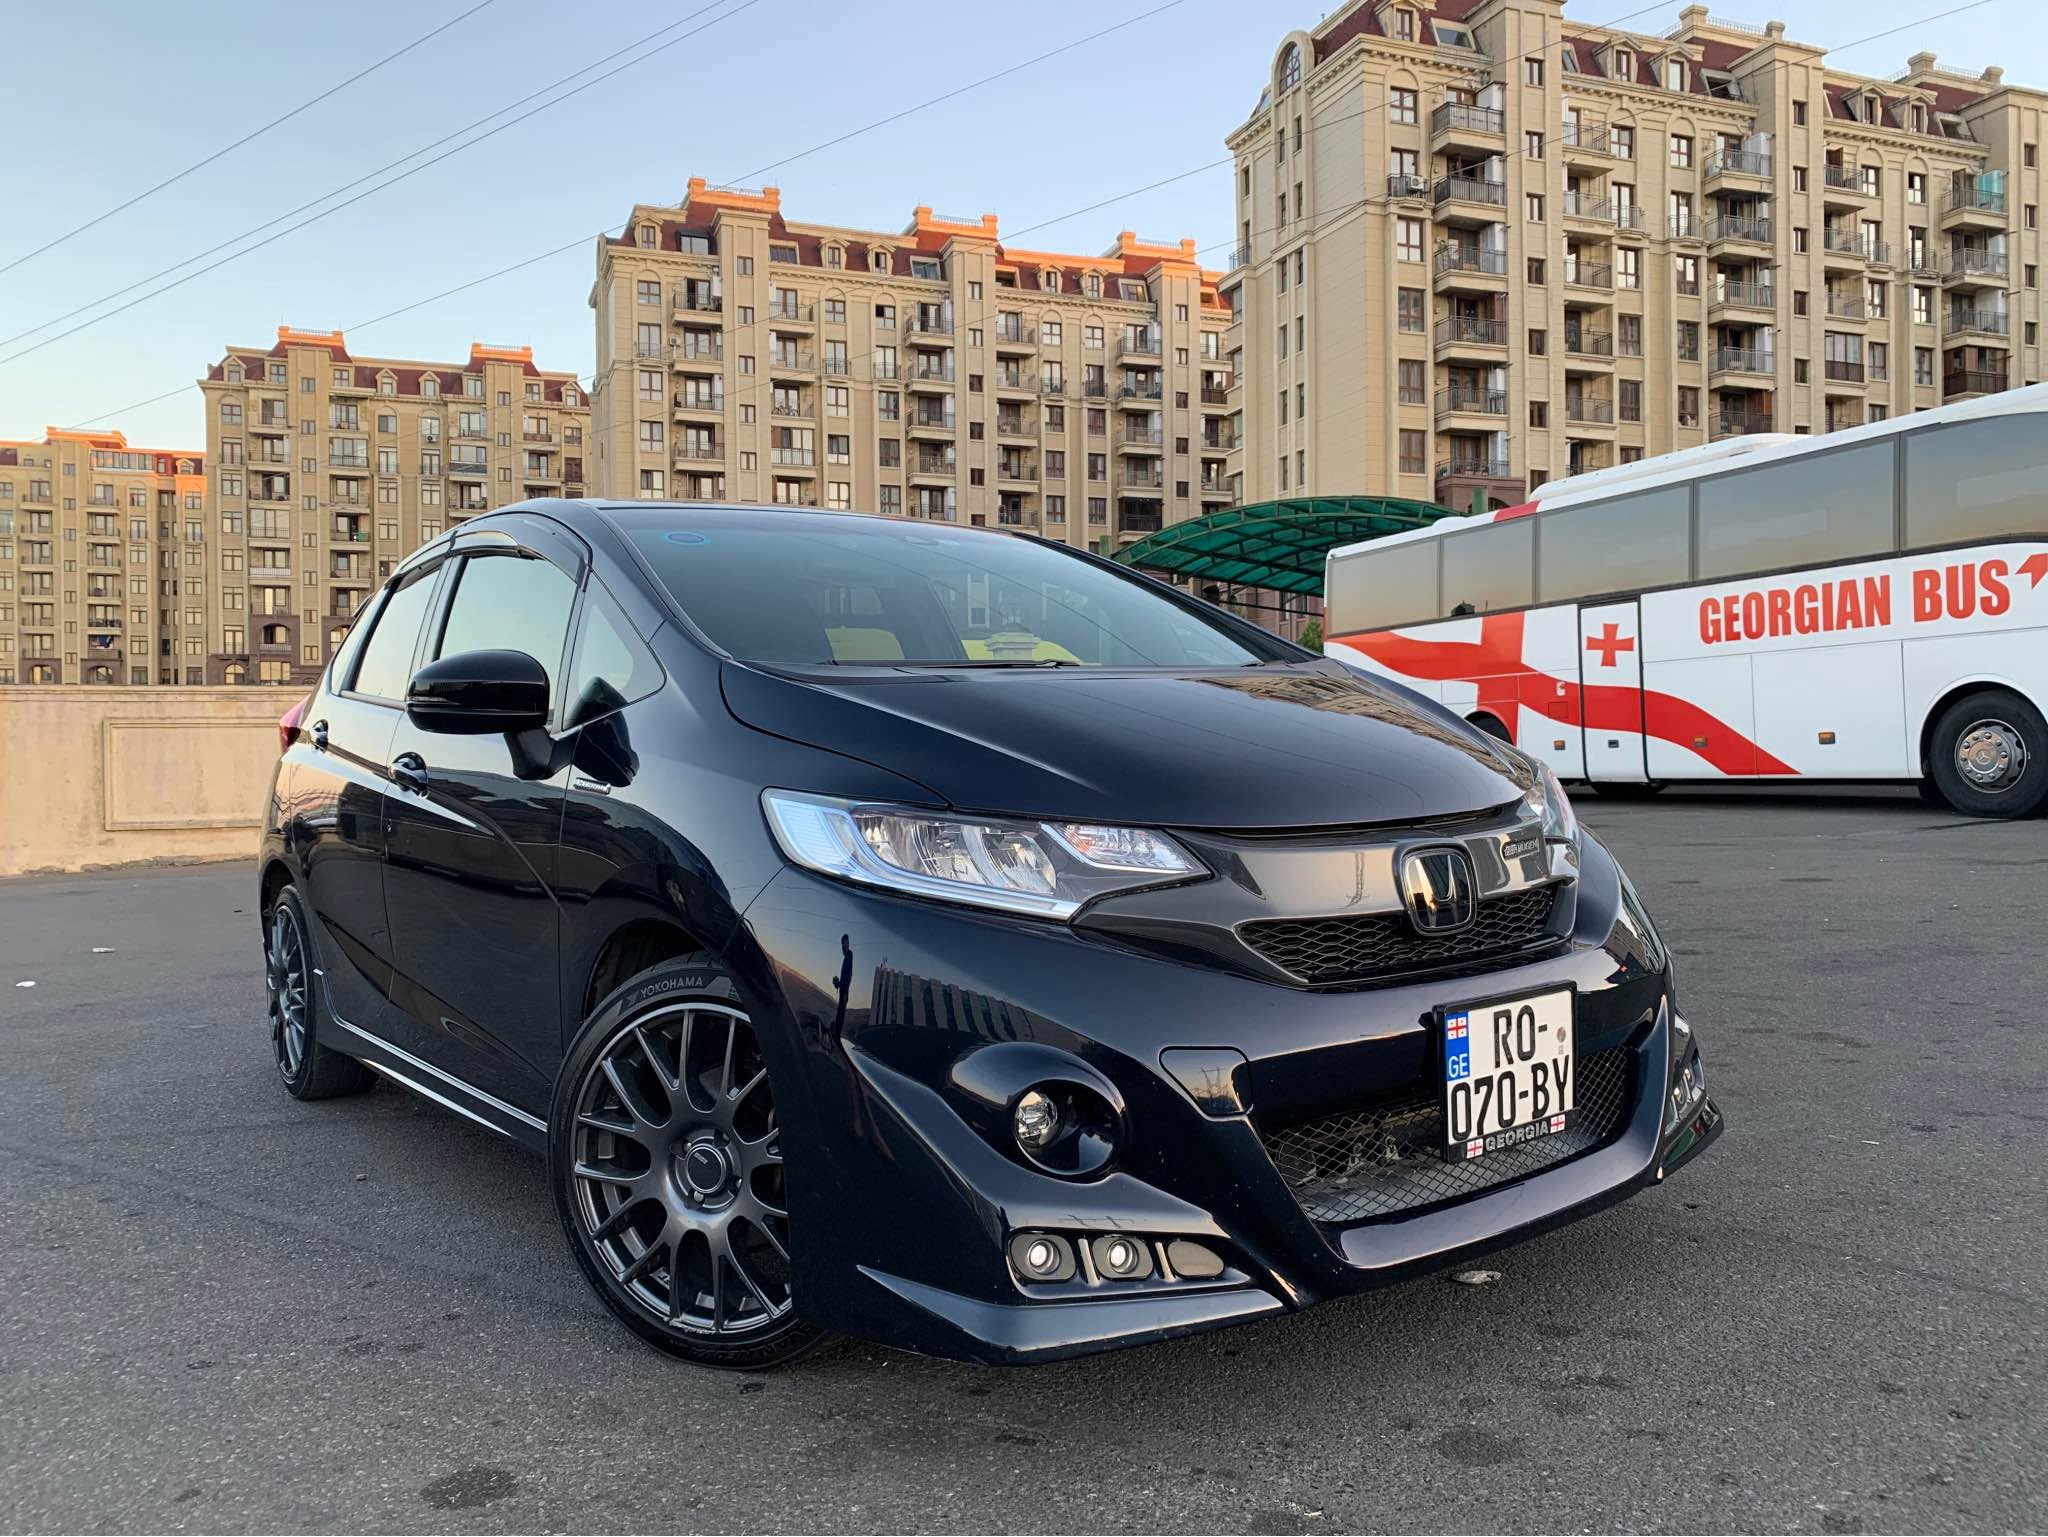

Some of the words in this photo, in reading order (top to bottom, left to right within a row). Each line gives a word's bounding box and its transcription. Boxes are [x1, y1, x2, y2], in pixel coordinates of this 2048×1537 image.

[1699, 574, 1892, 645] GEORGIAN
[1912, 559, 2011, 623] BUS
[640, 976, 703, 996] YOKOHAMA
[1449, 1053, 1468, 1078] GE
[1451, 1054, 1570, 1142] 070-BY
[1485, 1120, 1549, 1152] GEORGIA
